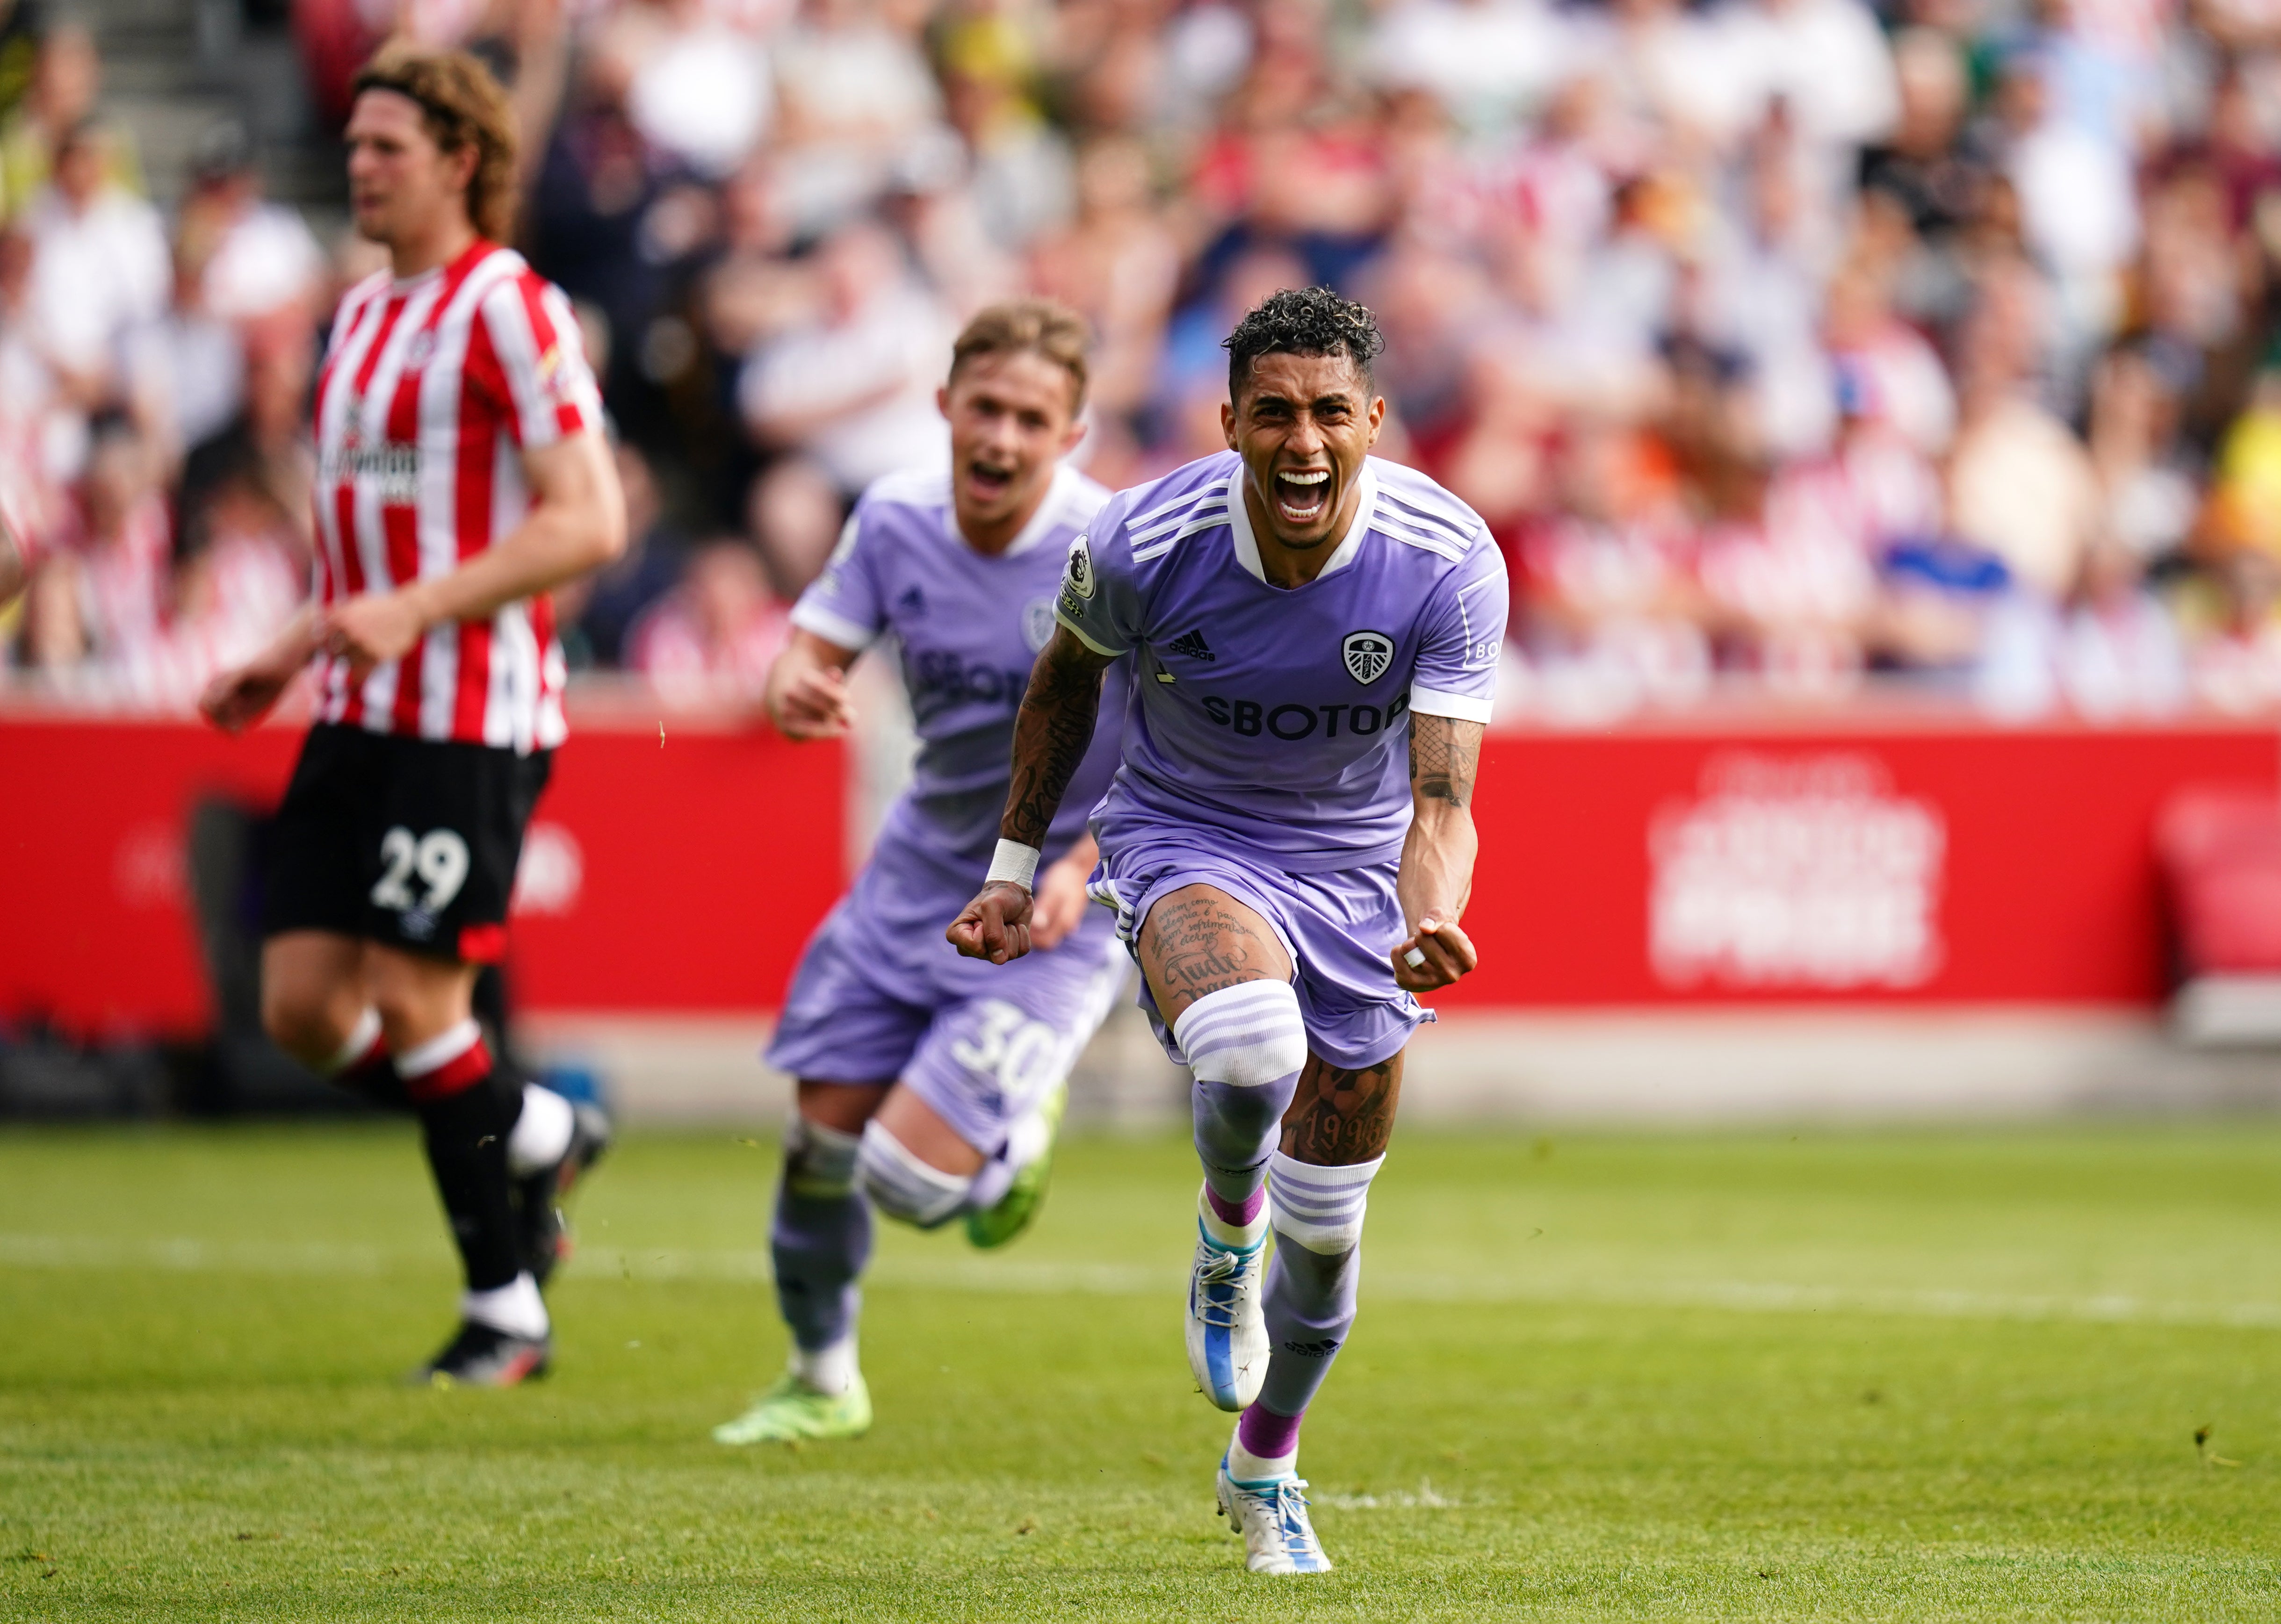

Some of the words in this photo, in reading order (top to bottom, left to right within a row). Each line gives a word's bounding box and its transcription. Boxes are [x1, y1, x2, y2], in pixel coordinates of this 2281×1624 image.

[1169, 643, 1215, 661] adidas
[1201, 693, 1409, 741] SBOTOP
[369, 825, 469, 912] 29
[1164, 945, 1248, 987] Tudo
[1171, 969, 1266, 1002] pas
[952, 999, 1057, 1096] 30
